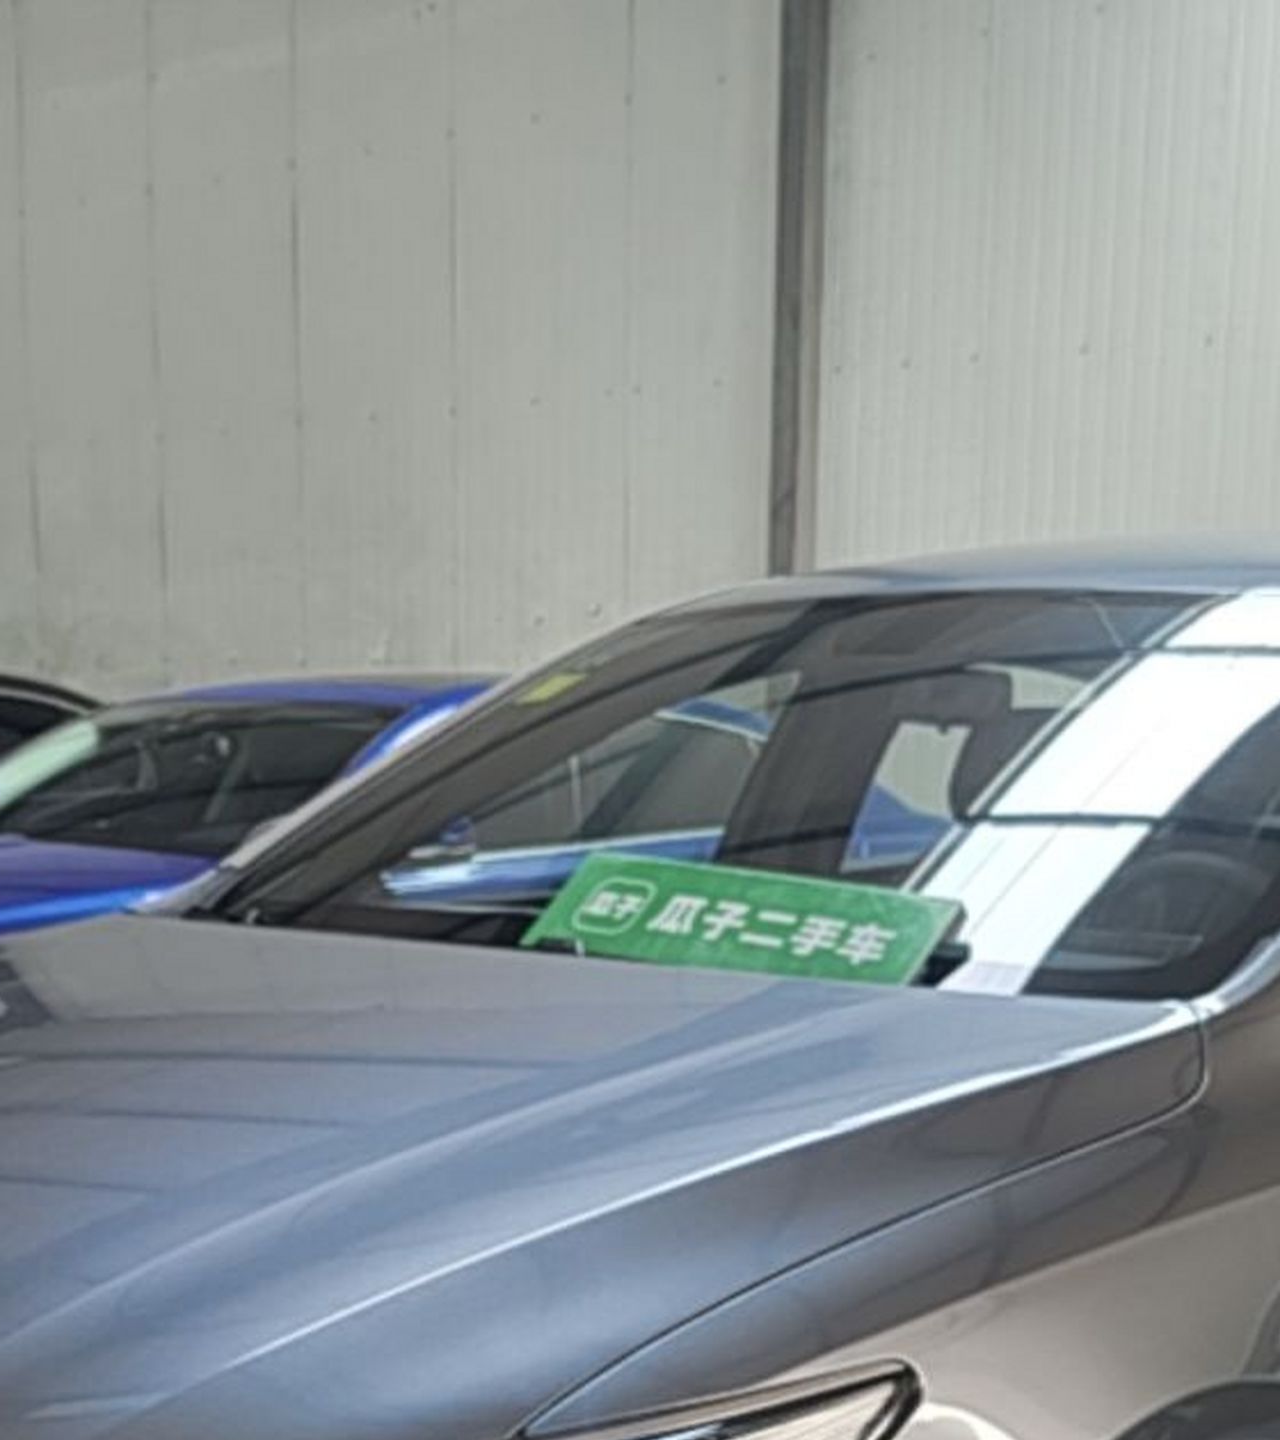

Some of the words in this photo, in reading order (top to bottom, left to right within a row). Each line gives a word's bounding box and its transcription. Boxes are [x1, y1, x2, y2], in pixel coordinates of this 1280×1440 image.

[646, 893, 898, 966] 瓜子二手车
